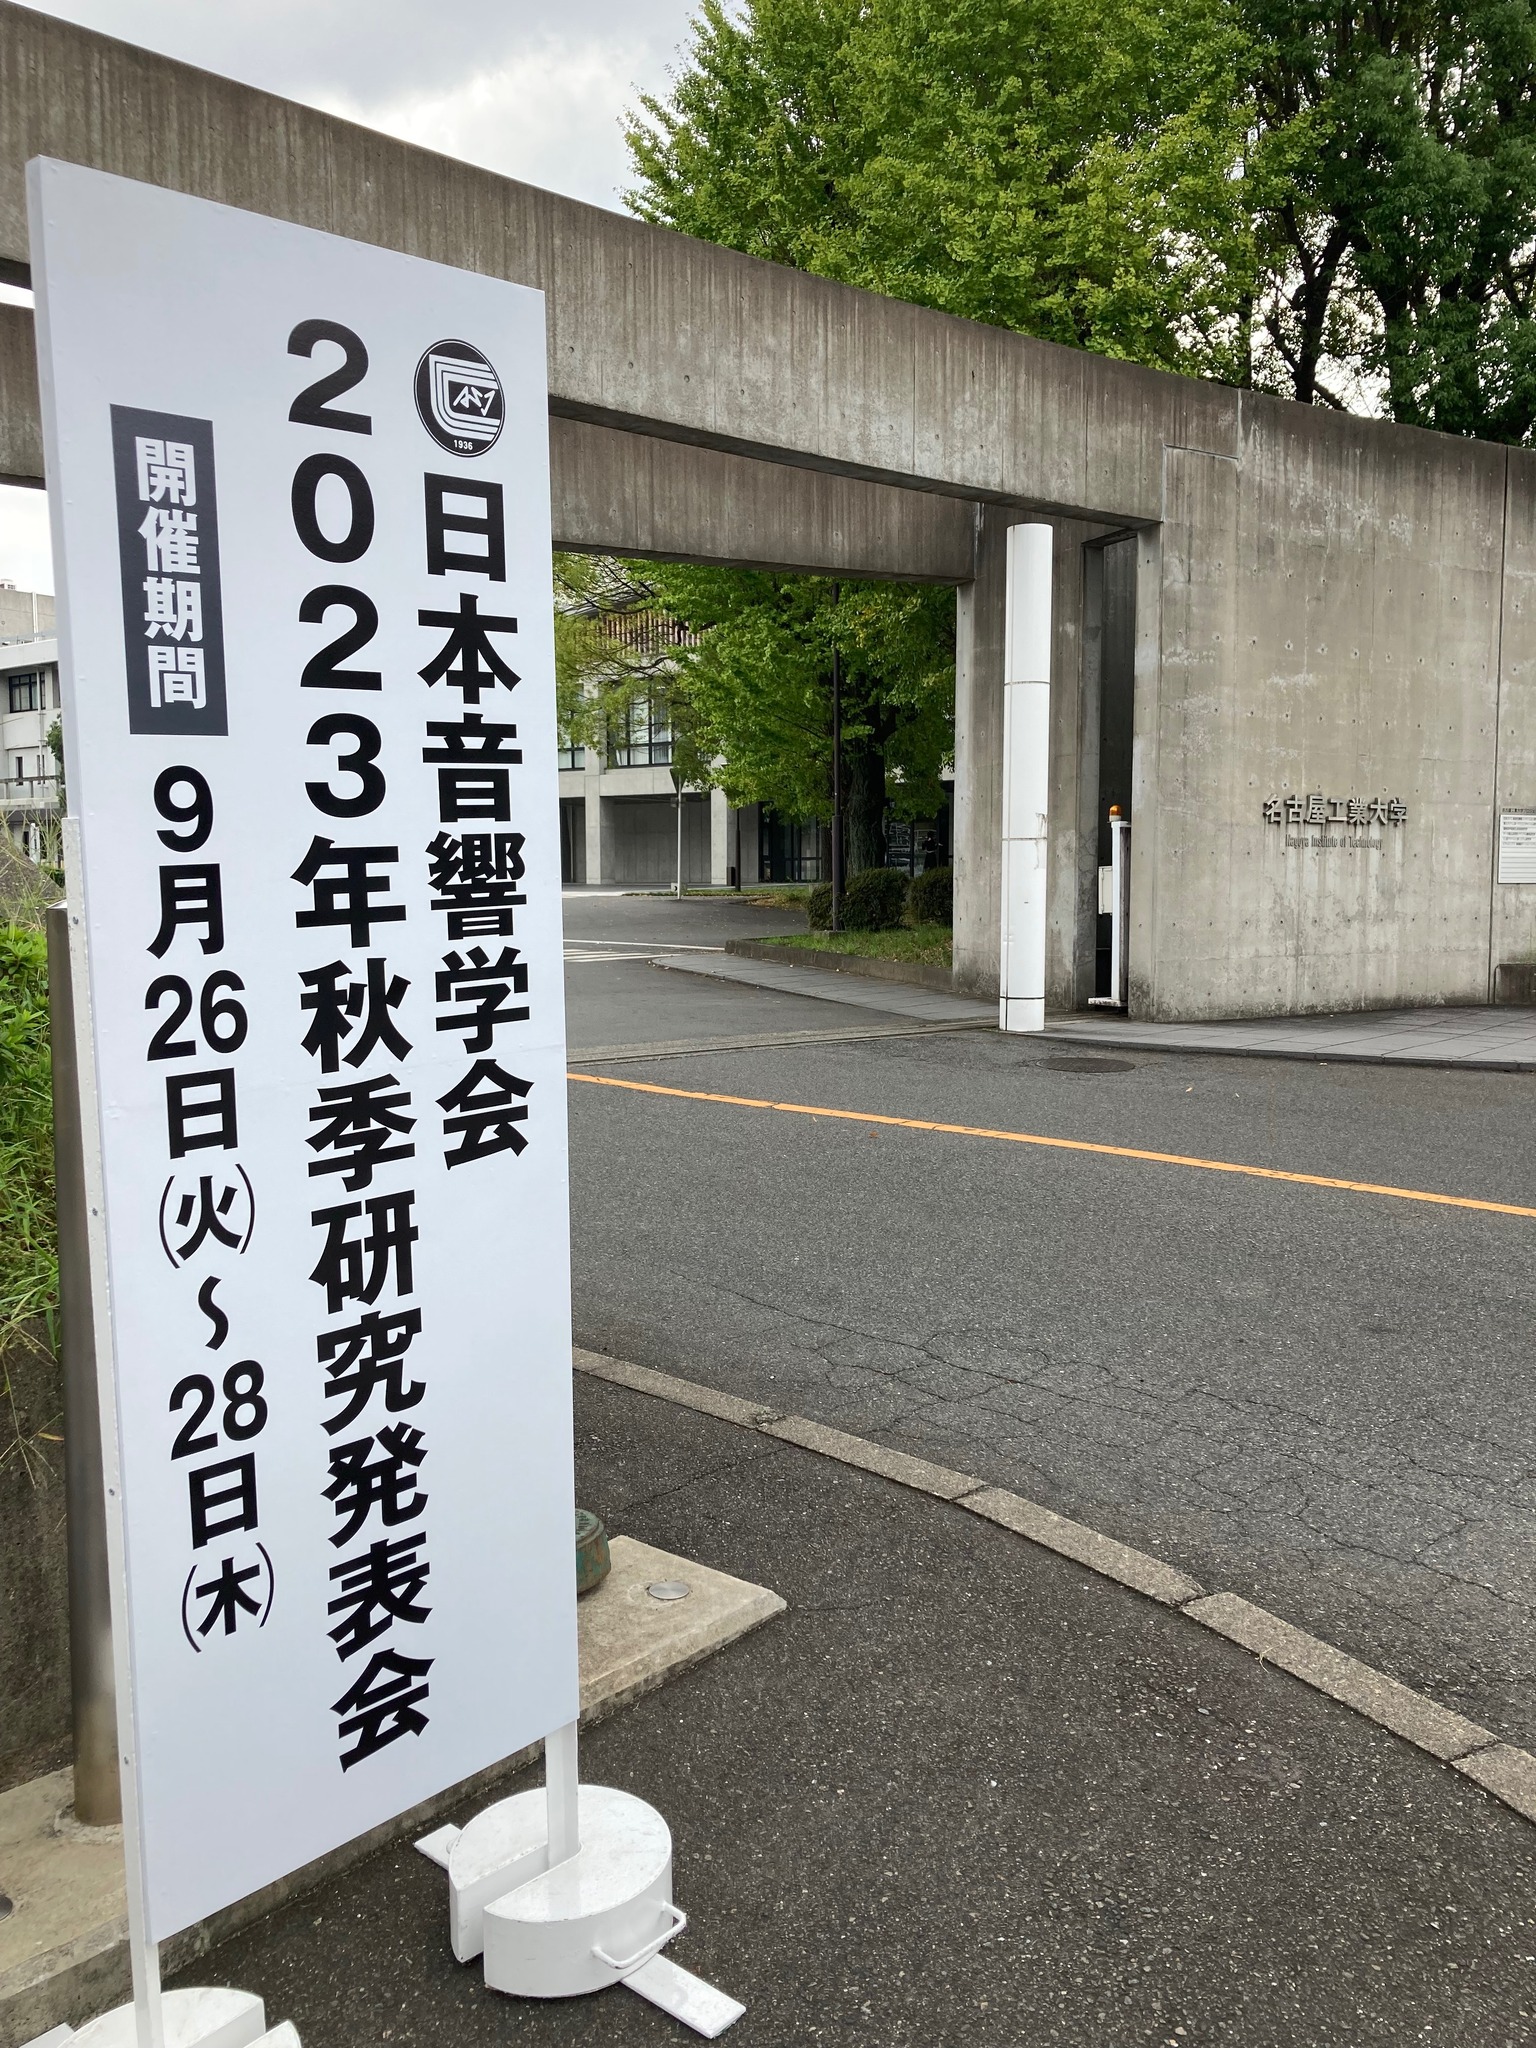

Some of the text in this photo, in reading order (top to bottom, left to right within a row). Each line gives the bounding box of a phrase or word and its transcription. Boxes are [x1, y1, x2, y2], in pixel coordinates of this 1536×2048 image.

[134, 435, 207, 710] 開催期間
[453, 439, 473, 451] 1936
[418, 472, 534, 1170] 日本音響学会
[1263, 793, 1409, 827] 名古屋工業大学
[288, 320, 435, 1773] 2023年秋季研究発表会
